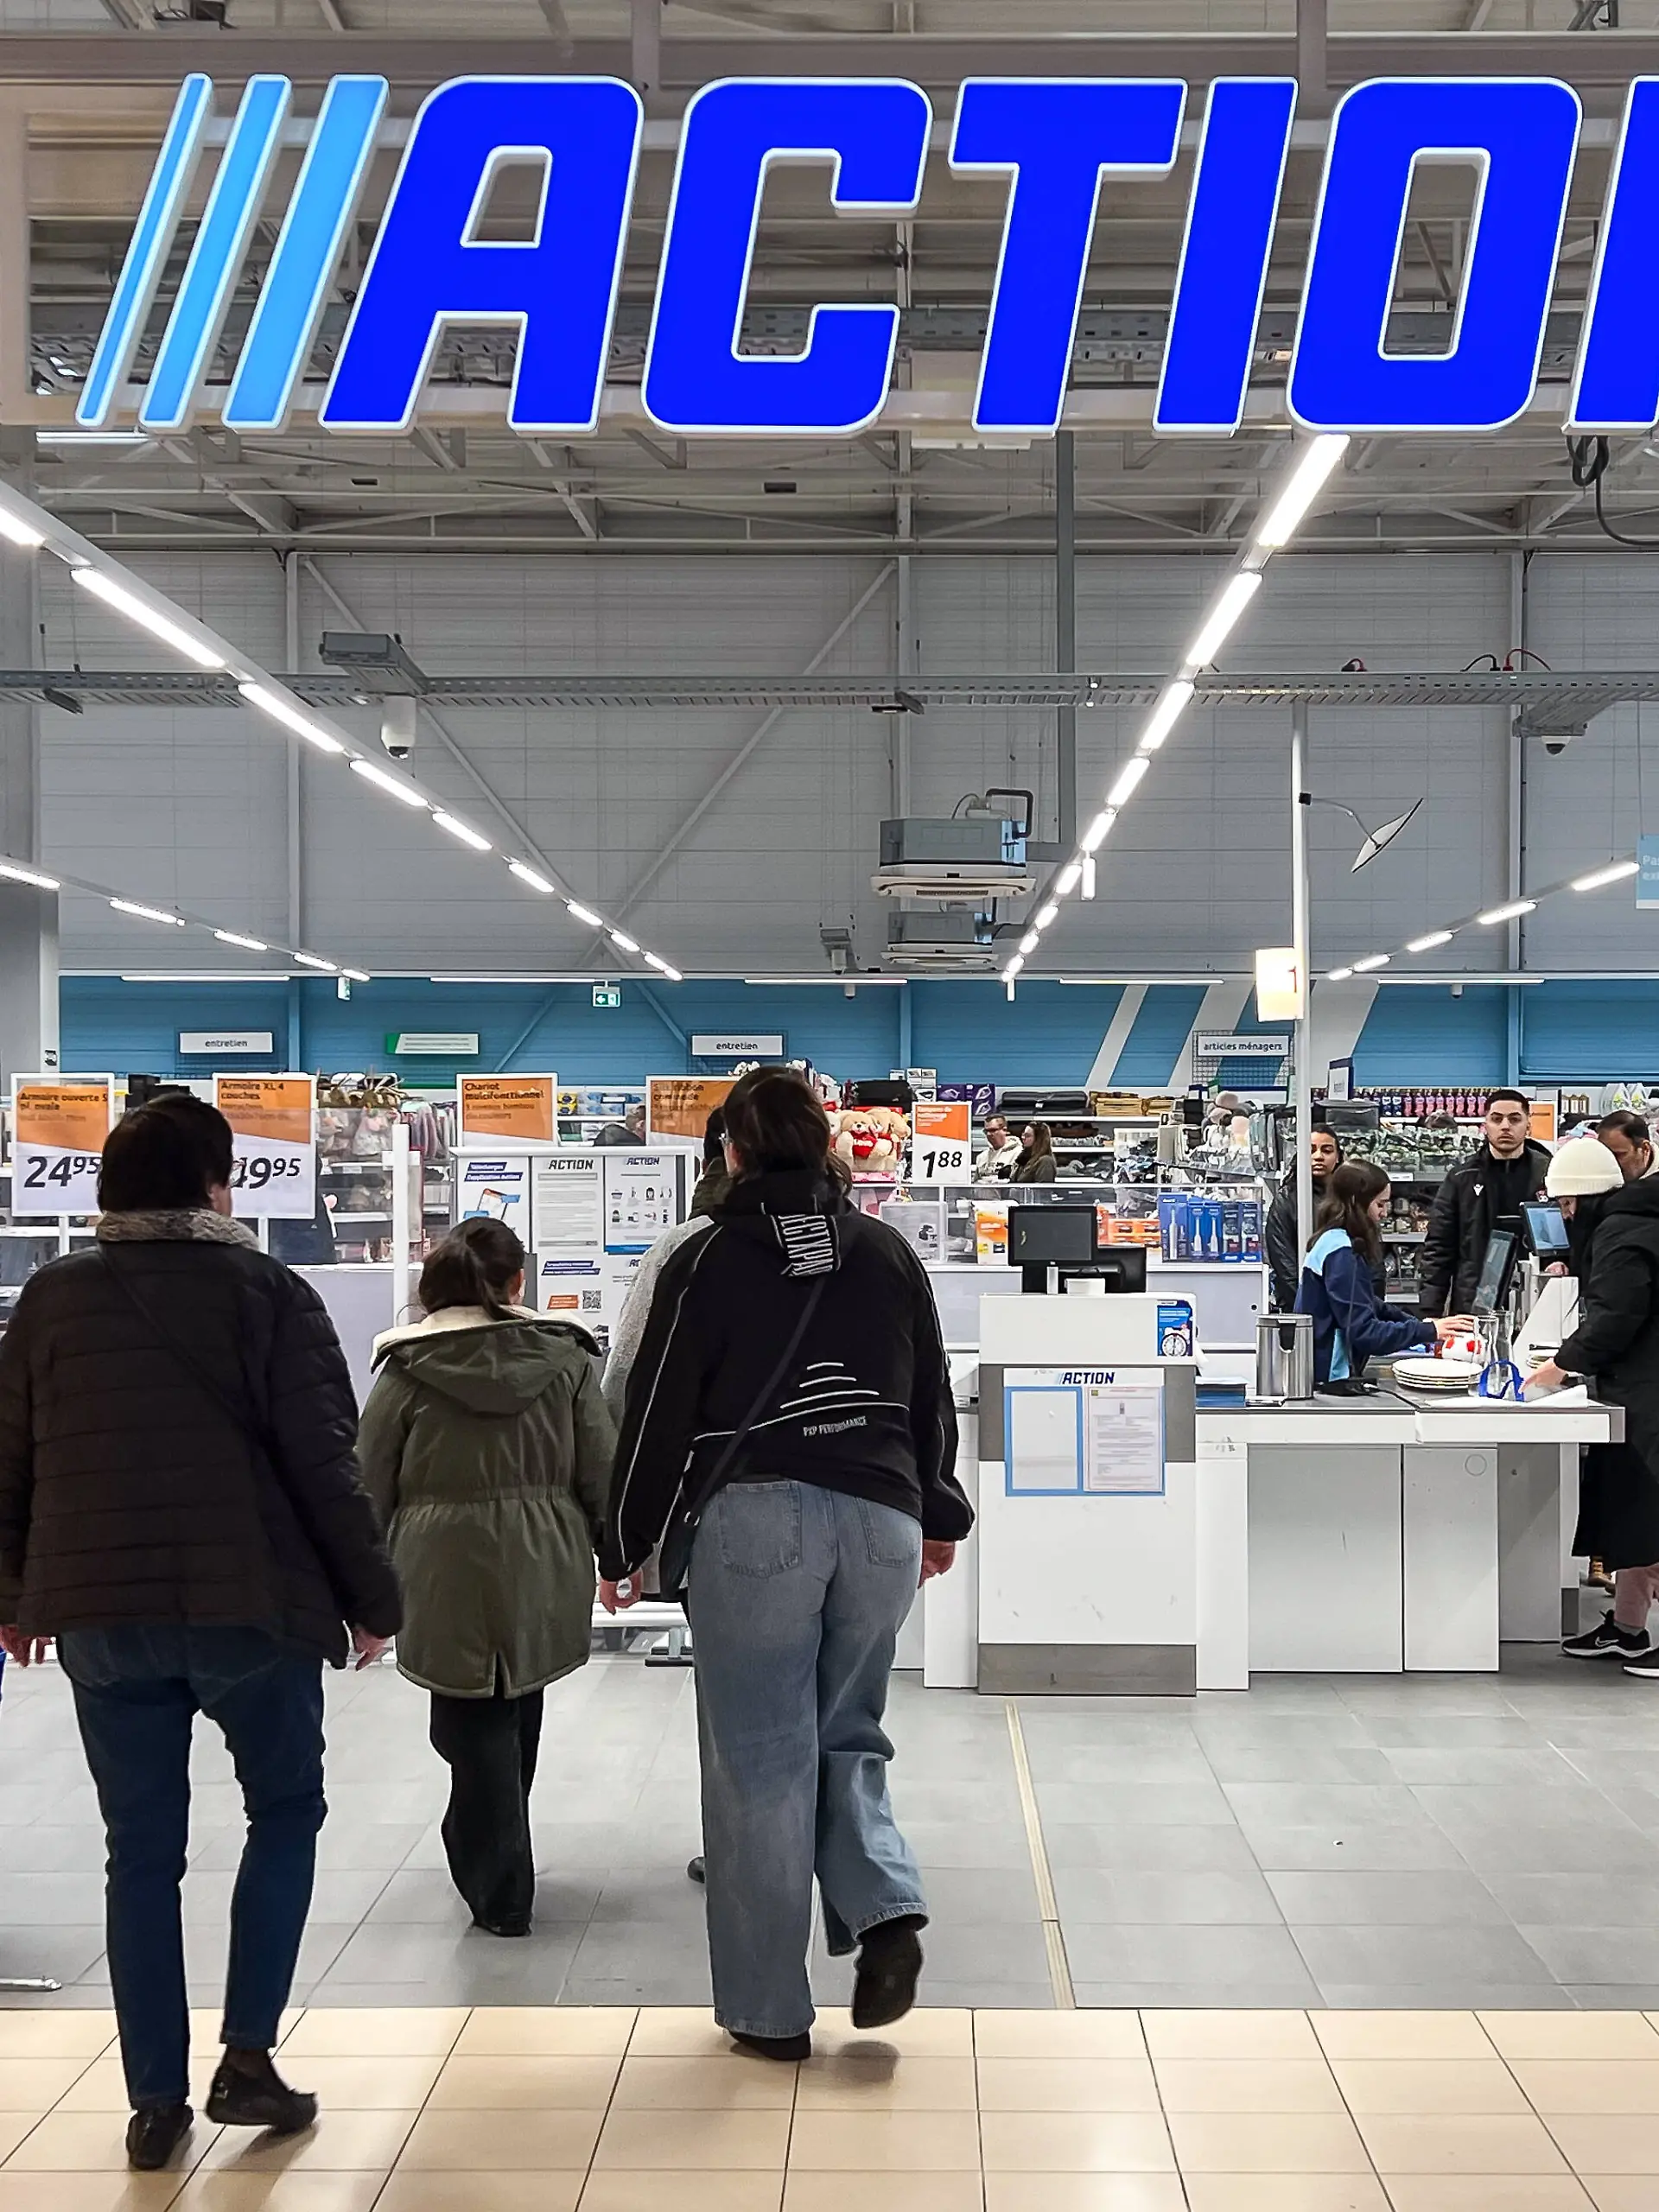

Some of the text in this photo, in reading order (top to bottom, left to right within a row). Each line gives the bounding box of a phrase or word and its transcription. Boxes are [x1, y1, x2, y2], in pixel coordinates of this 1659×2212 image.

[1643, 855, 1659, 867] Pa
[715, 1041, 759, 1050] entretien
[1204, 1041, 1283, 1052] articles ménagers
[264, 1082, 276, 1090] XL
[548, 1160, 594, 1170] ACTION
[626, 1157, 660, 1166] ACTION
[1062, 1372, 1116, 1384] ACTION
